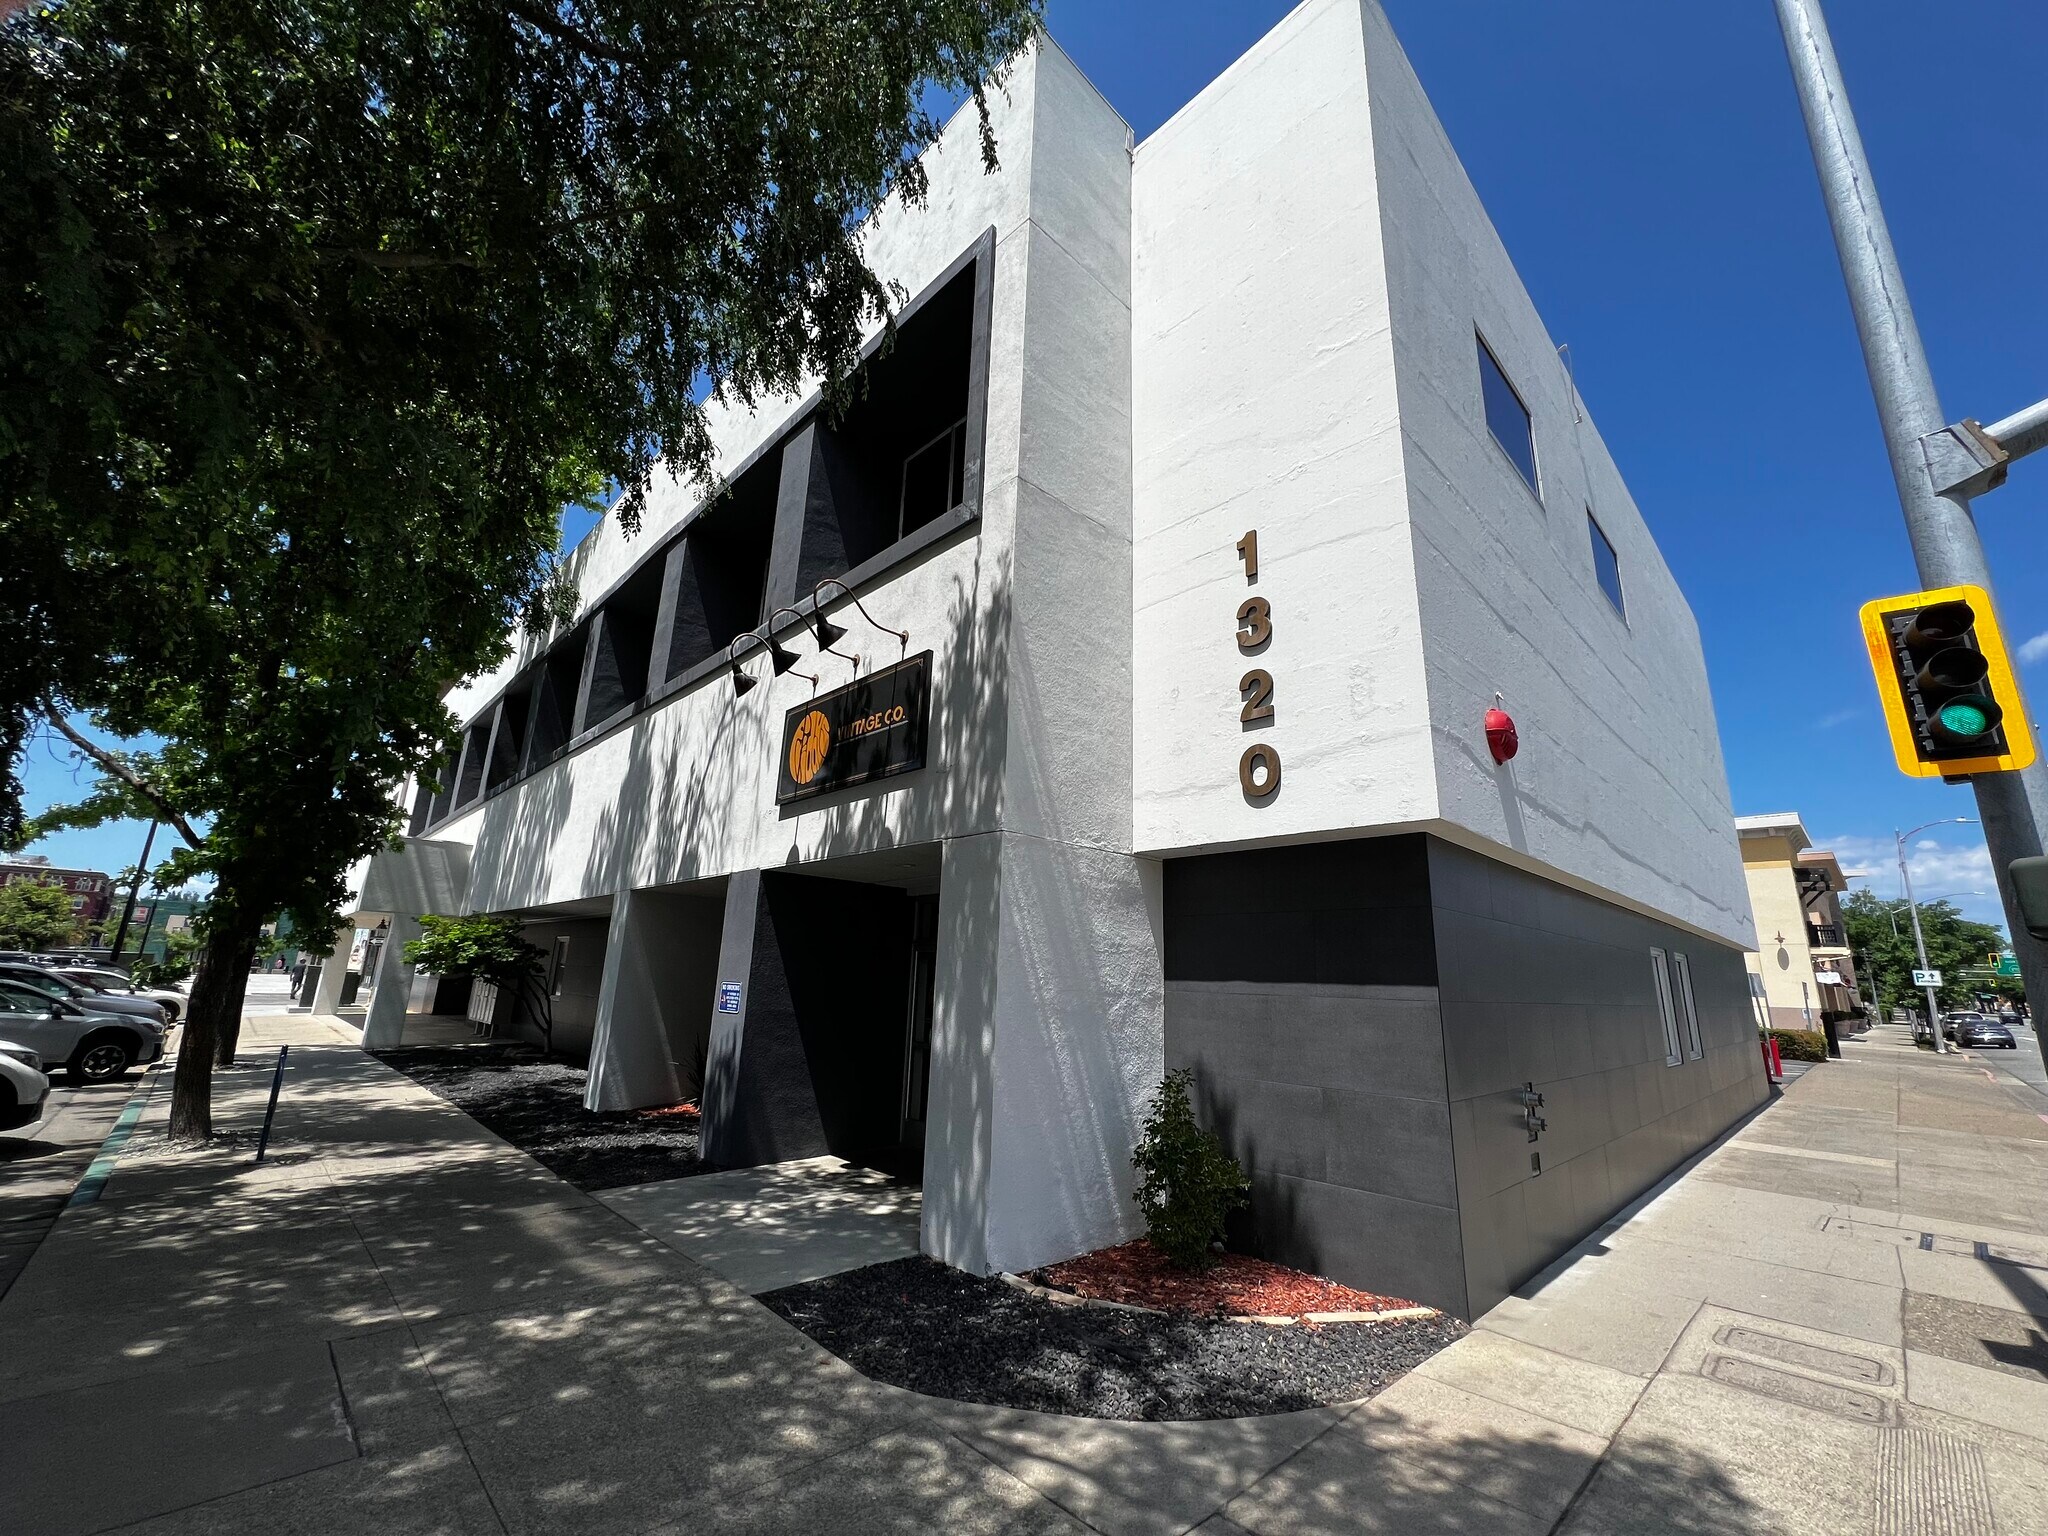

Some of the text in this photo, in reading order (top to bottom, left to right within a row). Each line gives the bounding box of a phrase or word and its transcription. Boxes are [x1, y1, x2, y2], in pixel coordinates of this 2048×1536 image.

[837, 705, 906, 741] VINTAGE CO.
[1236, 529, 1281, 799] 1320
